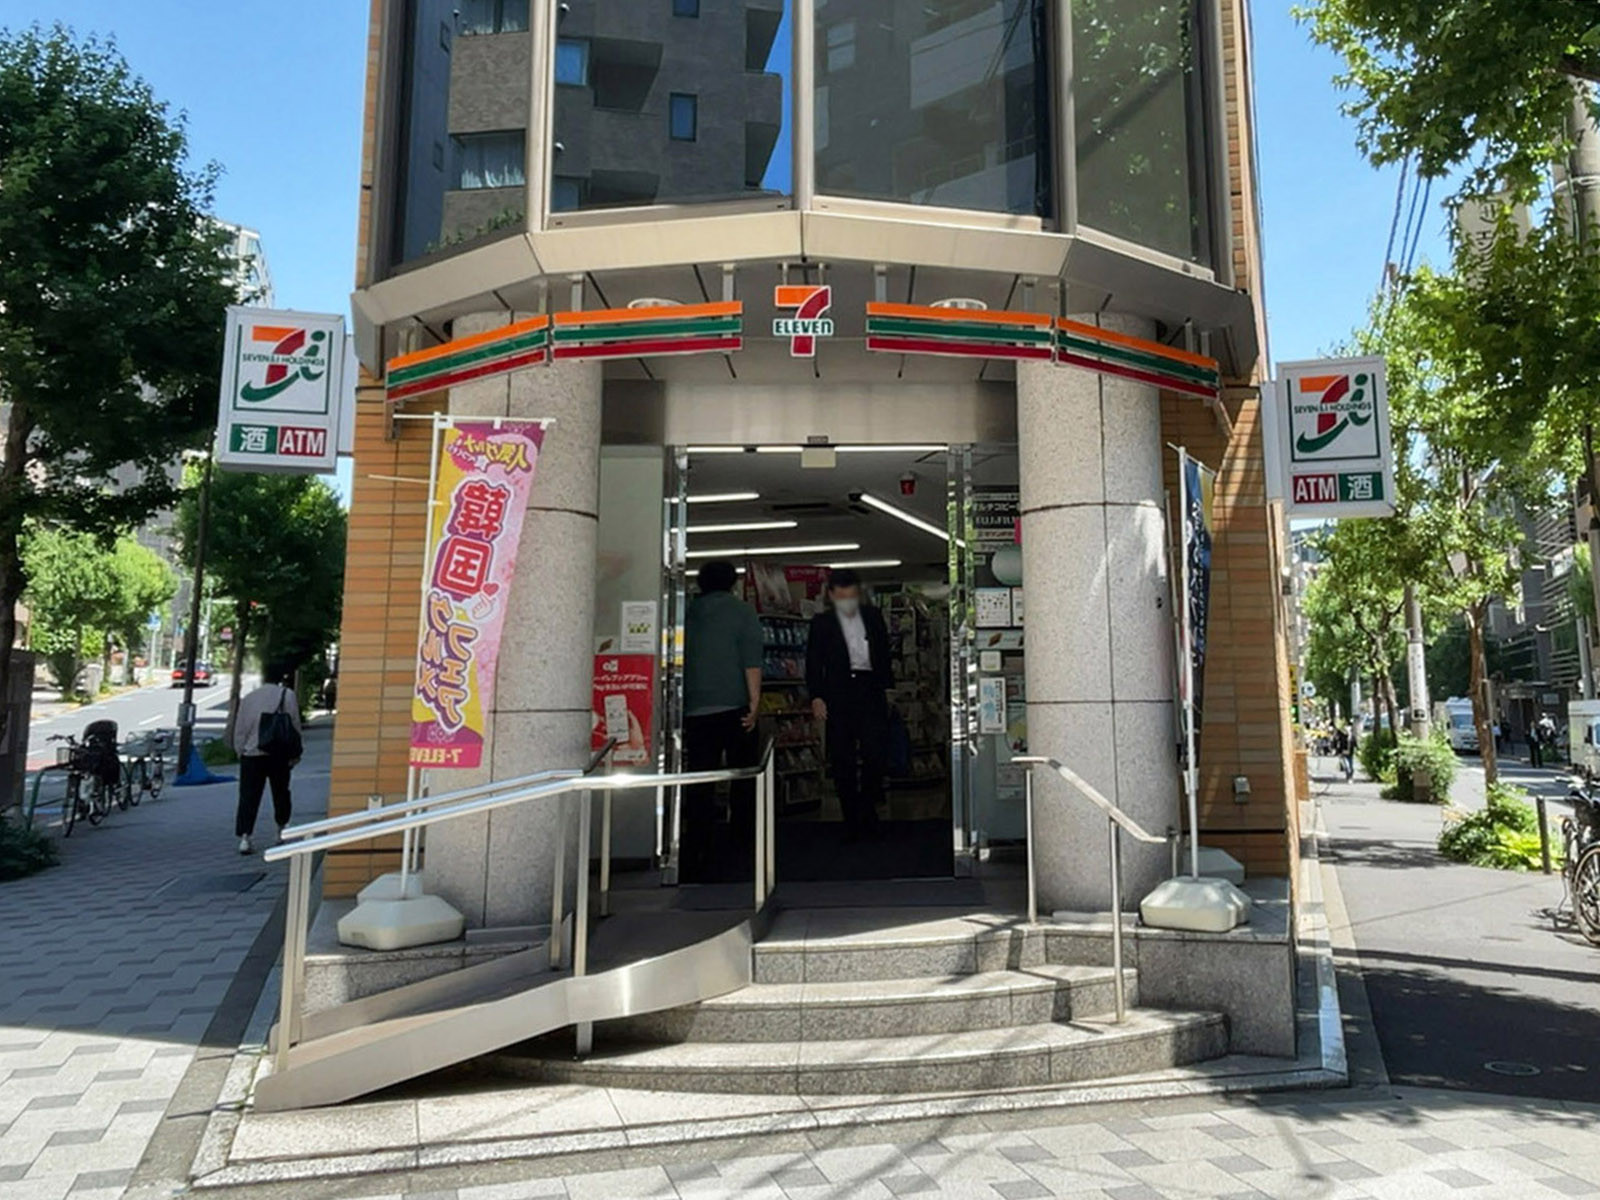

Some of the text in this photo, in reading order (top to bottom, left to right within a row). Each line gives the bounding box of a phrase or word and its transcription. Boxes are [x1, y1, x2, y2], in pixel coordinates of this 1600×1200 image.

[281, 356, 325, 367] HOLDINGS
[1329, 401, 1372, 412] HOLDINGS
[240, 427, 269, 452] 酒
[280, 429, 325, 455] ATM
[1296, 477, 1338, 502] ATM
[1348, 474, 1373, 500] 酒
